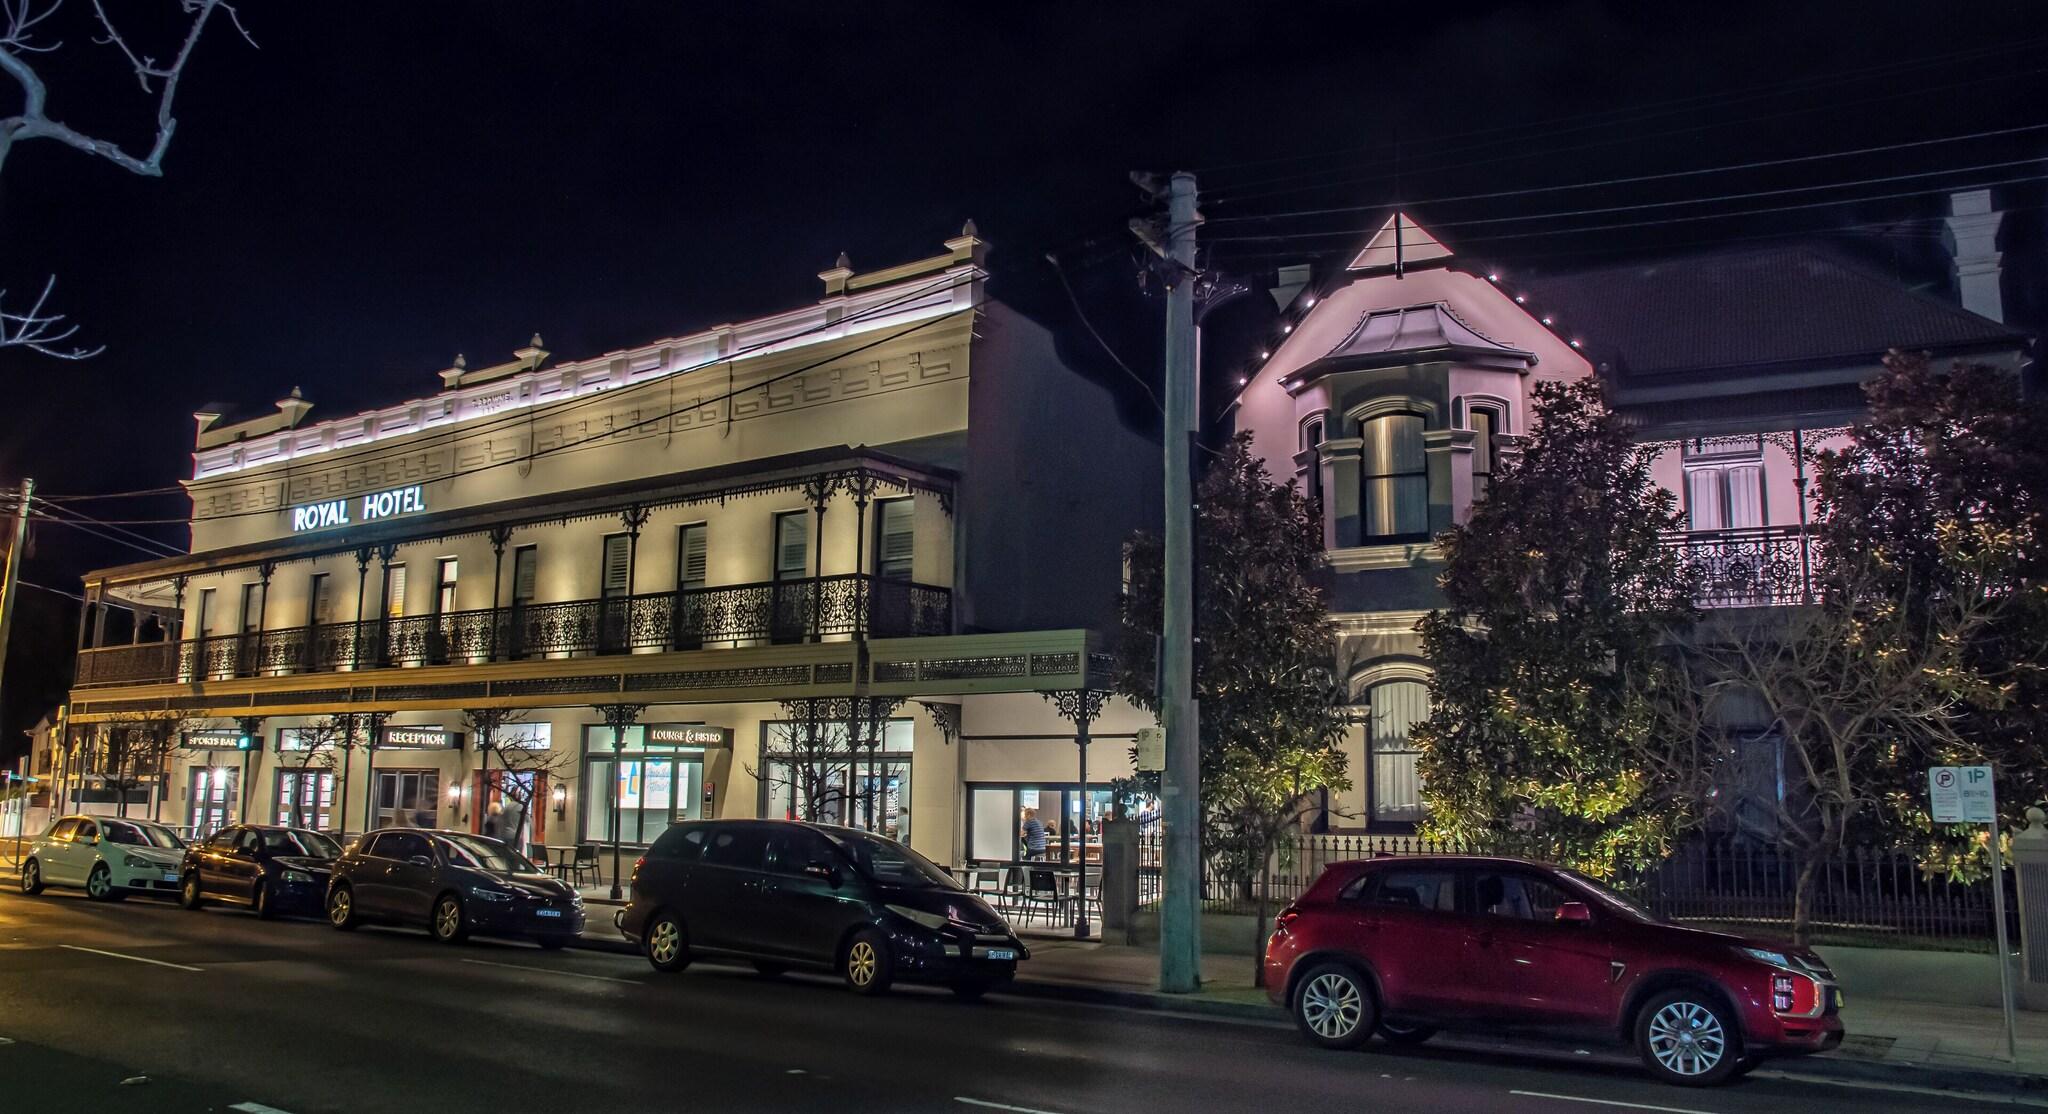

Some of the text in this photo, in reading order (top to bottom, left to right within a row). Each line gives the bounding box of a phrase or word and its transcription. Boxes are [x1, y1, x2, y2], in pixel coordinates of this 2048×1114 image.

[294, 486, 425, 531] ROYAL HOTEL
[189, 736, 237, 746] SPORTS BAR
[388, 731, 446, 745] RECEPTION
[652, 729, 720, 743] LOUNGE & BISTRO
[1968, 768, 1985, 784] 1P
